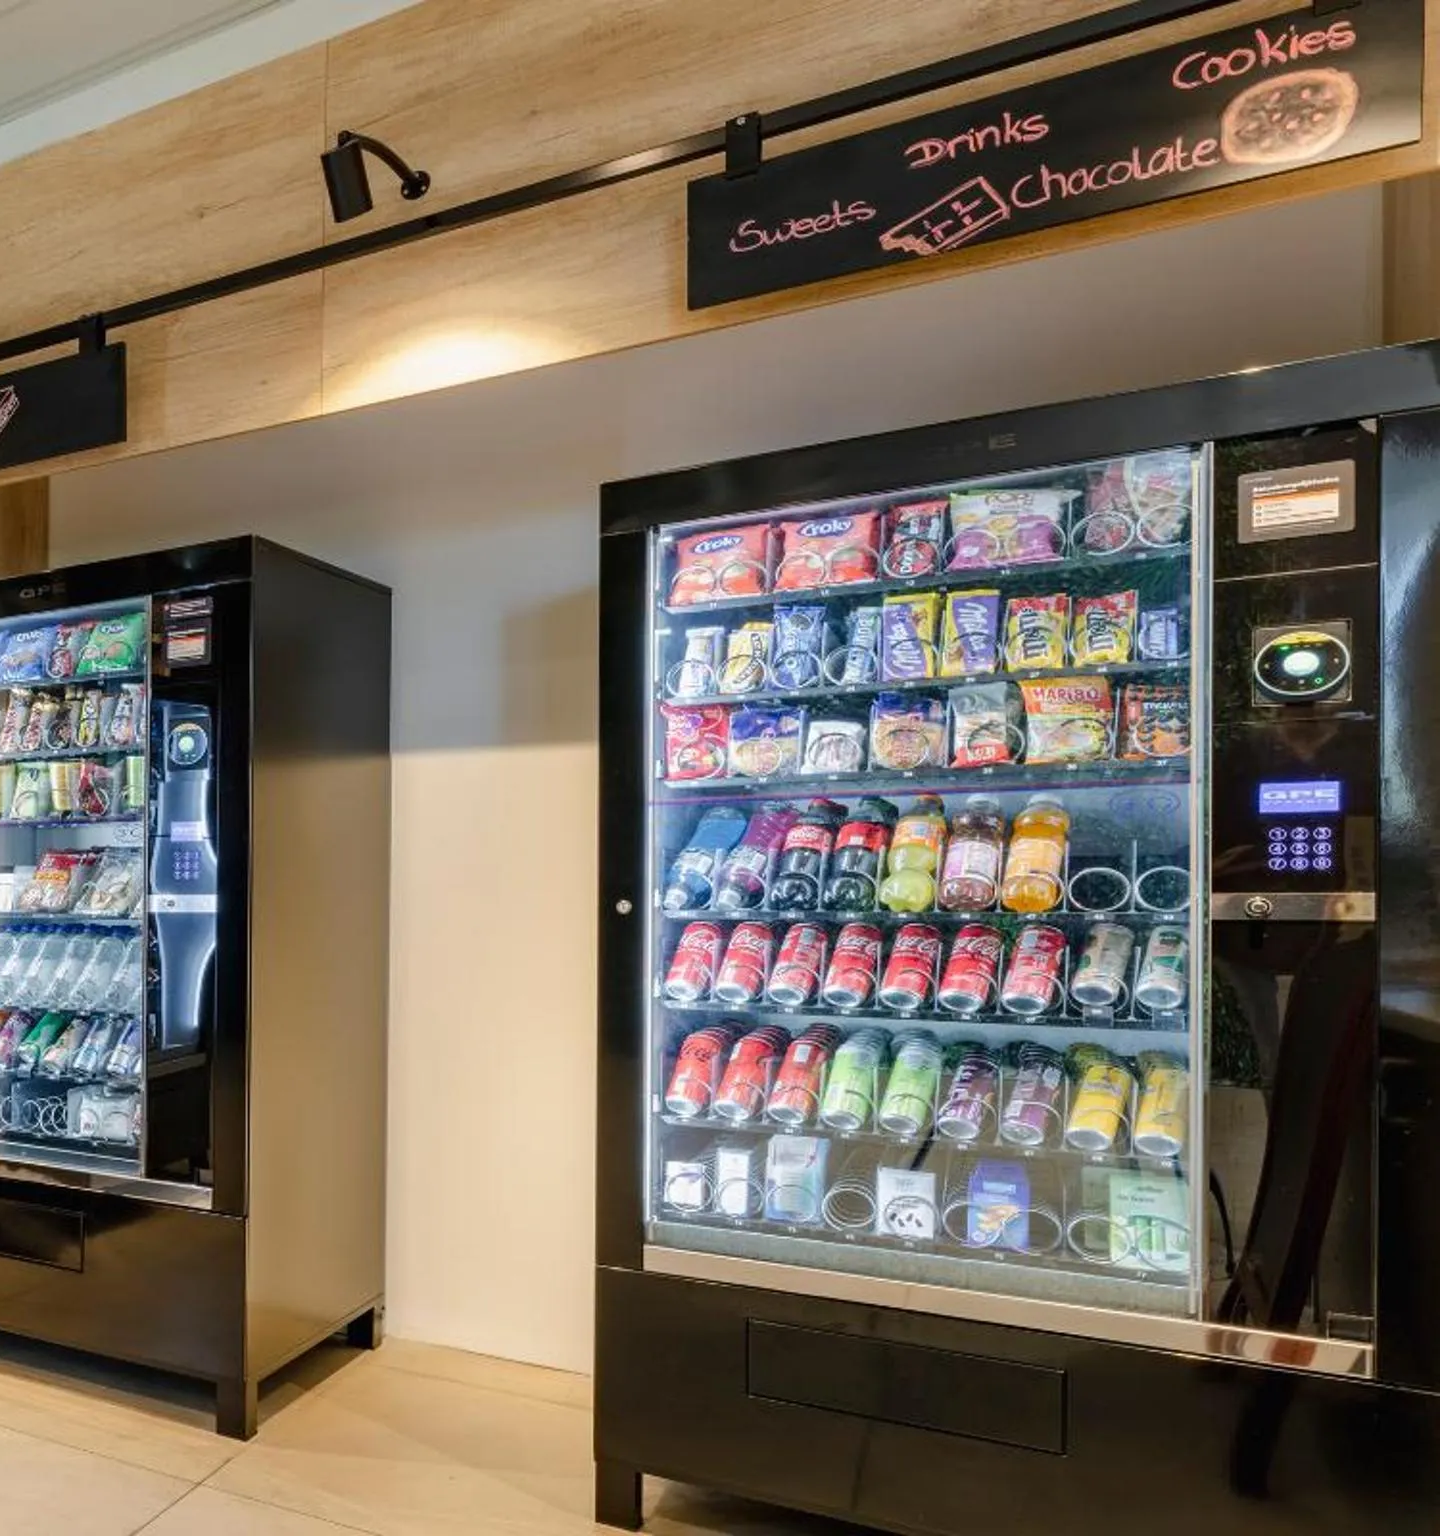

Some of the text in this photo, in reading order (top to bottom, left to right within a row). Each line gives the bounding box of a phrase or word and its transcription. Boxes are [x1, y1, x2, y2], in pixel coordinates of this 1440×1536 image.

[1171, 19, 1357, 91] Cookies
[903, 110, 1050, 168] Drinks
[1011, 135, 1220, 210] Chocolate
[728, 199, 878, 253] Sweets
[800, 519, 852, 538] Croky
